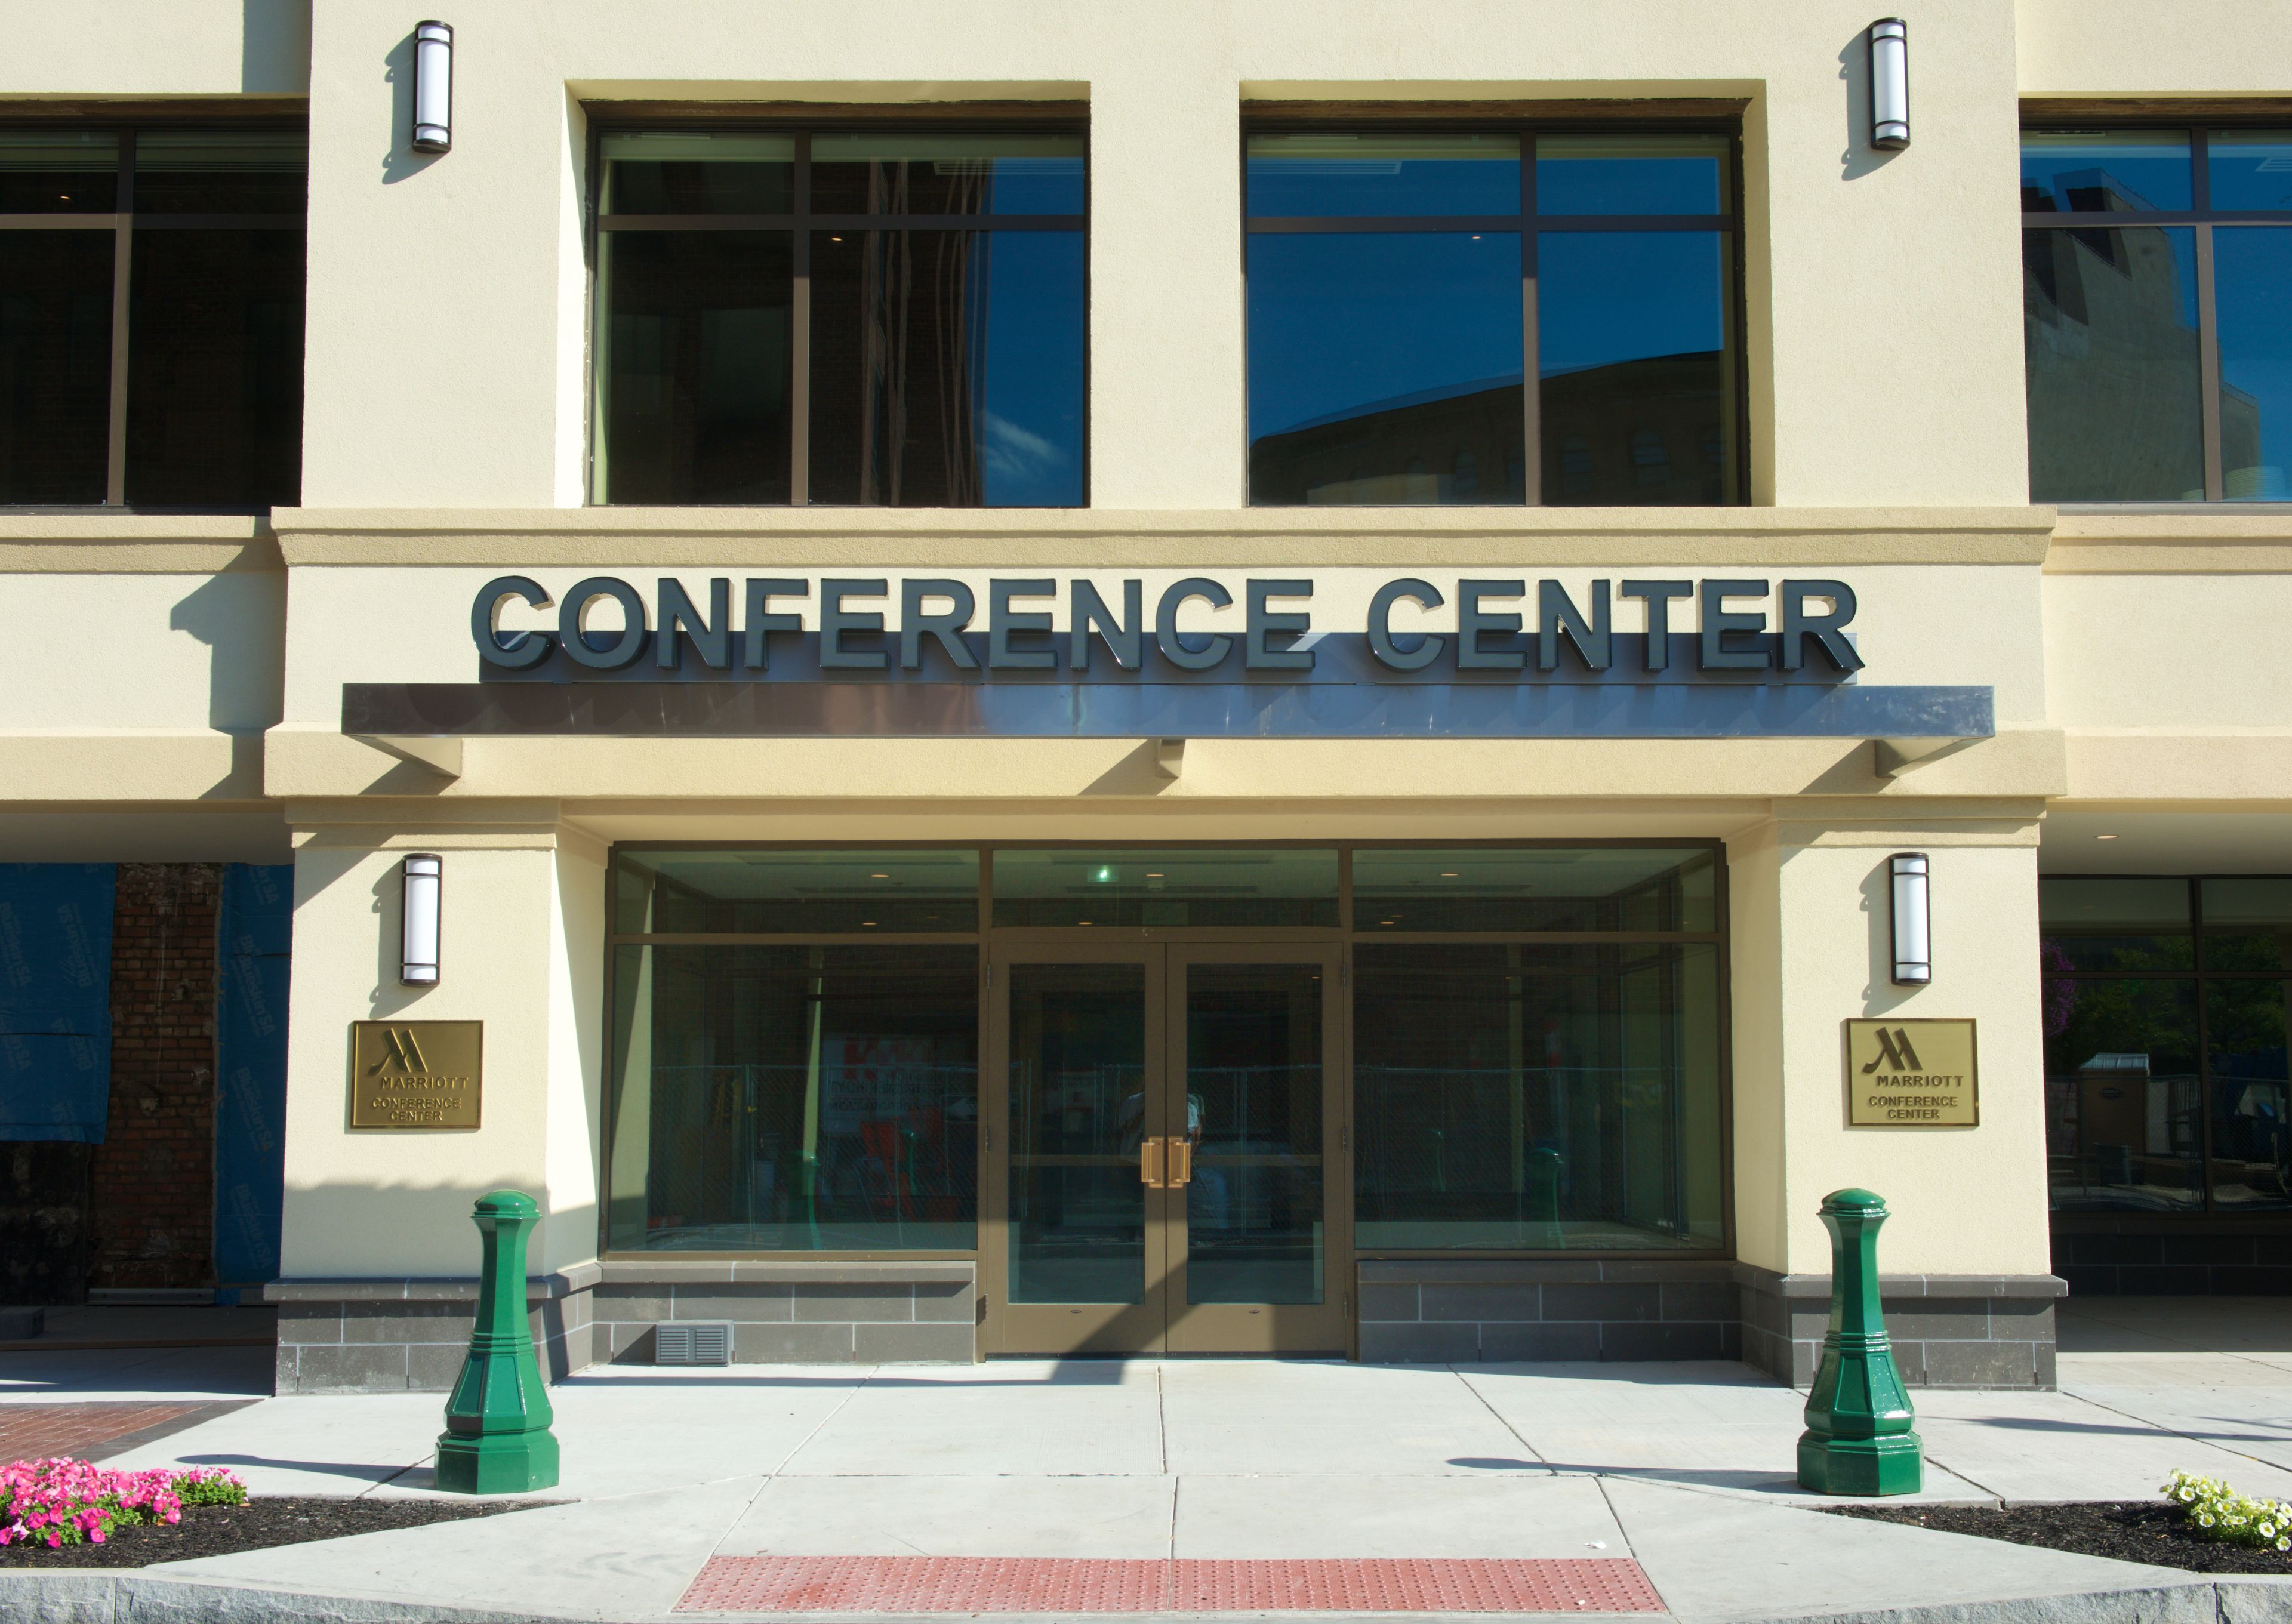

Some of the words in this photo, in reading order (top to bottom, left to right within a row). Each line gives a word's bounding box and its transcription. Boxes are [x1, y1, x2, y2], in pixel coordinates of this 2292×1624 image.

[471, 575, 1315, 672] CONFERENCE
[1367, 578, 1865, 673] CENTER
[259, 1015, 276, 1036] SA
[380, 1076, 469, 1089] MARRIOTT
[1877, 1075, 1964, 1087] MARRIOTT
[372, 1098, 461, 1108] CONFERENCE
[1868, 1096, 1958, 1107] CONFERENCE
[237, 1067, 265, 1131] Blueskin
[258, 1131, 275, 1152] SA
[390, 1110, 443, 1121] CENTER
[1887, 1108, 1940, 1119] CENTER
